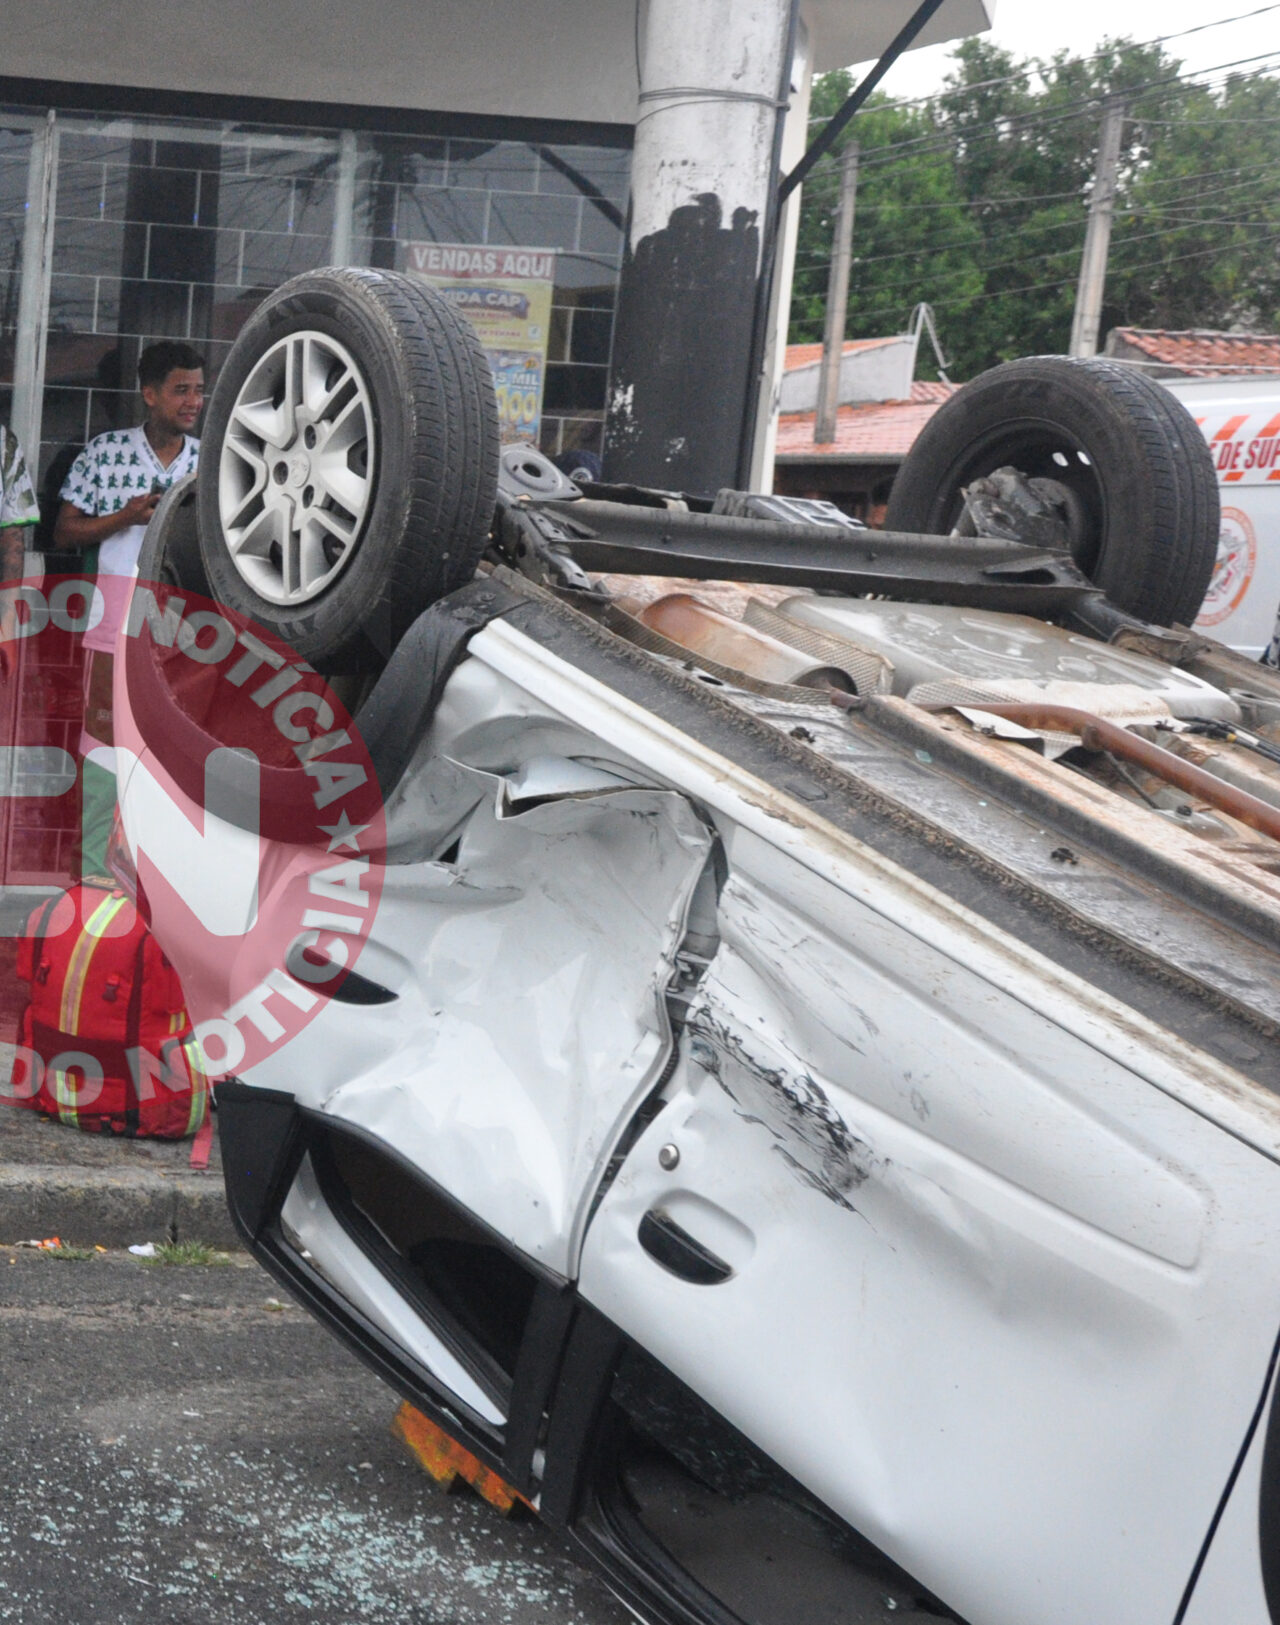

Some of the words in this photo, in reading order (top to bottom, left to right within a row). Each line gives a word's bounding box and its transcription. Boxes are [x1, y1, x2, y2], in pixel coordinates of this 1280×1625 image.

[414, 248, 497, 273] VENDAS
[502, 255, 553, 277] AQUI
[485, 292, 522, 307] CAP
[512, 372, 539, 385] MIL
[1216, 441, 1245, 470] DE
